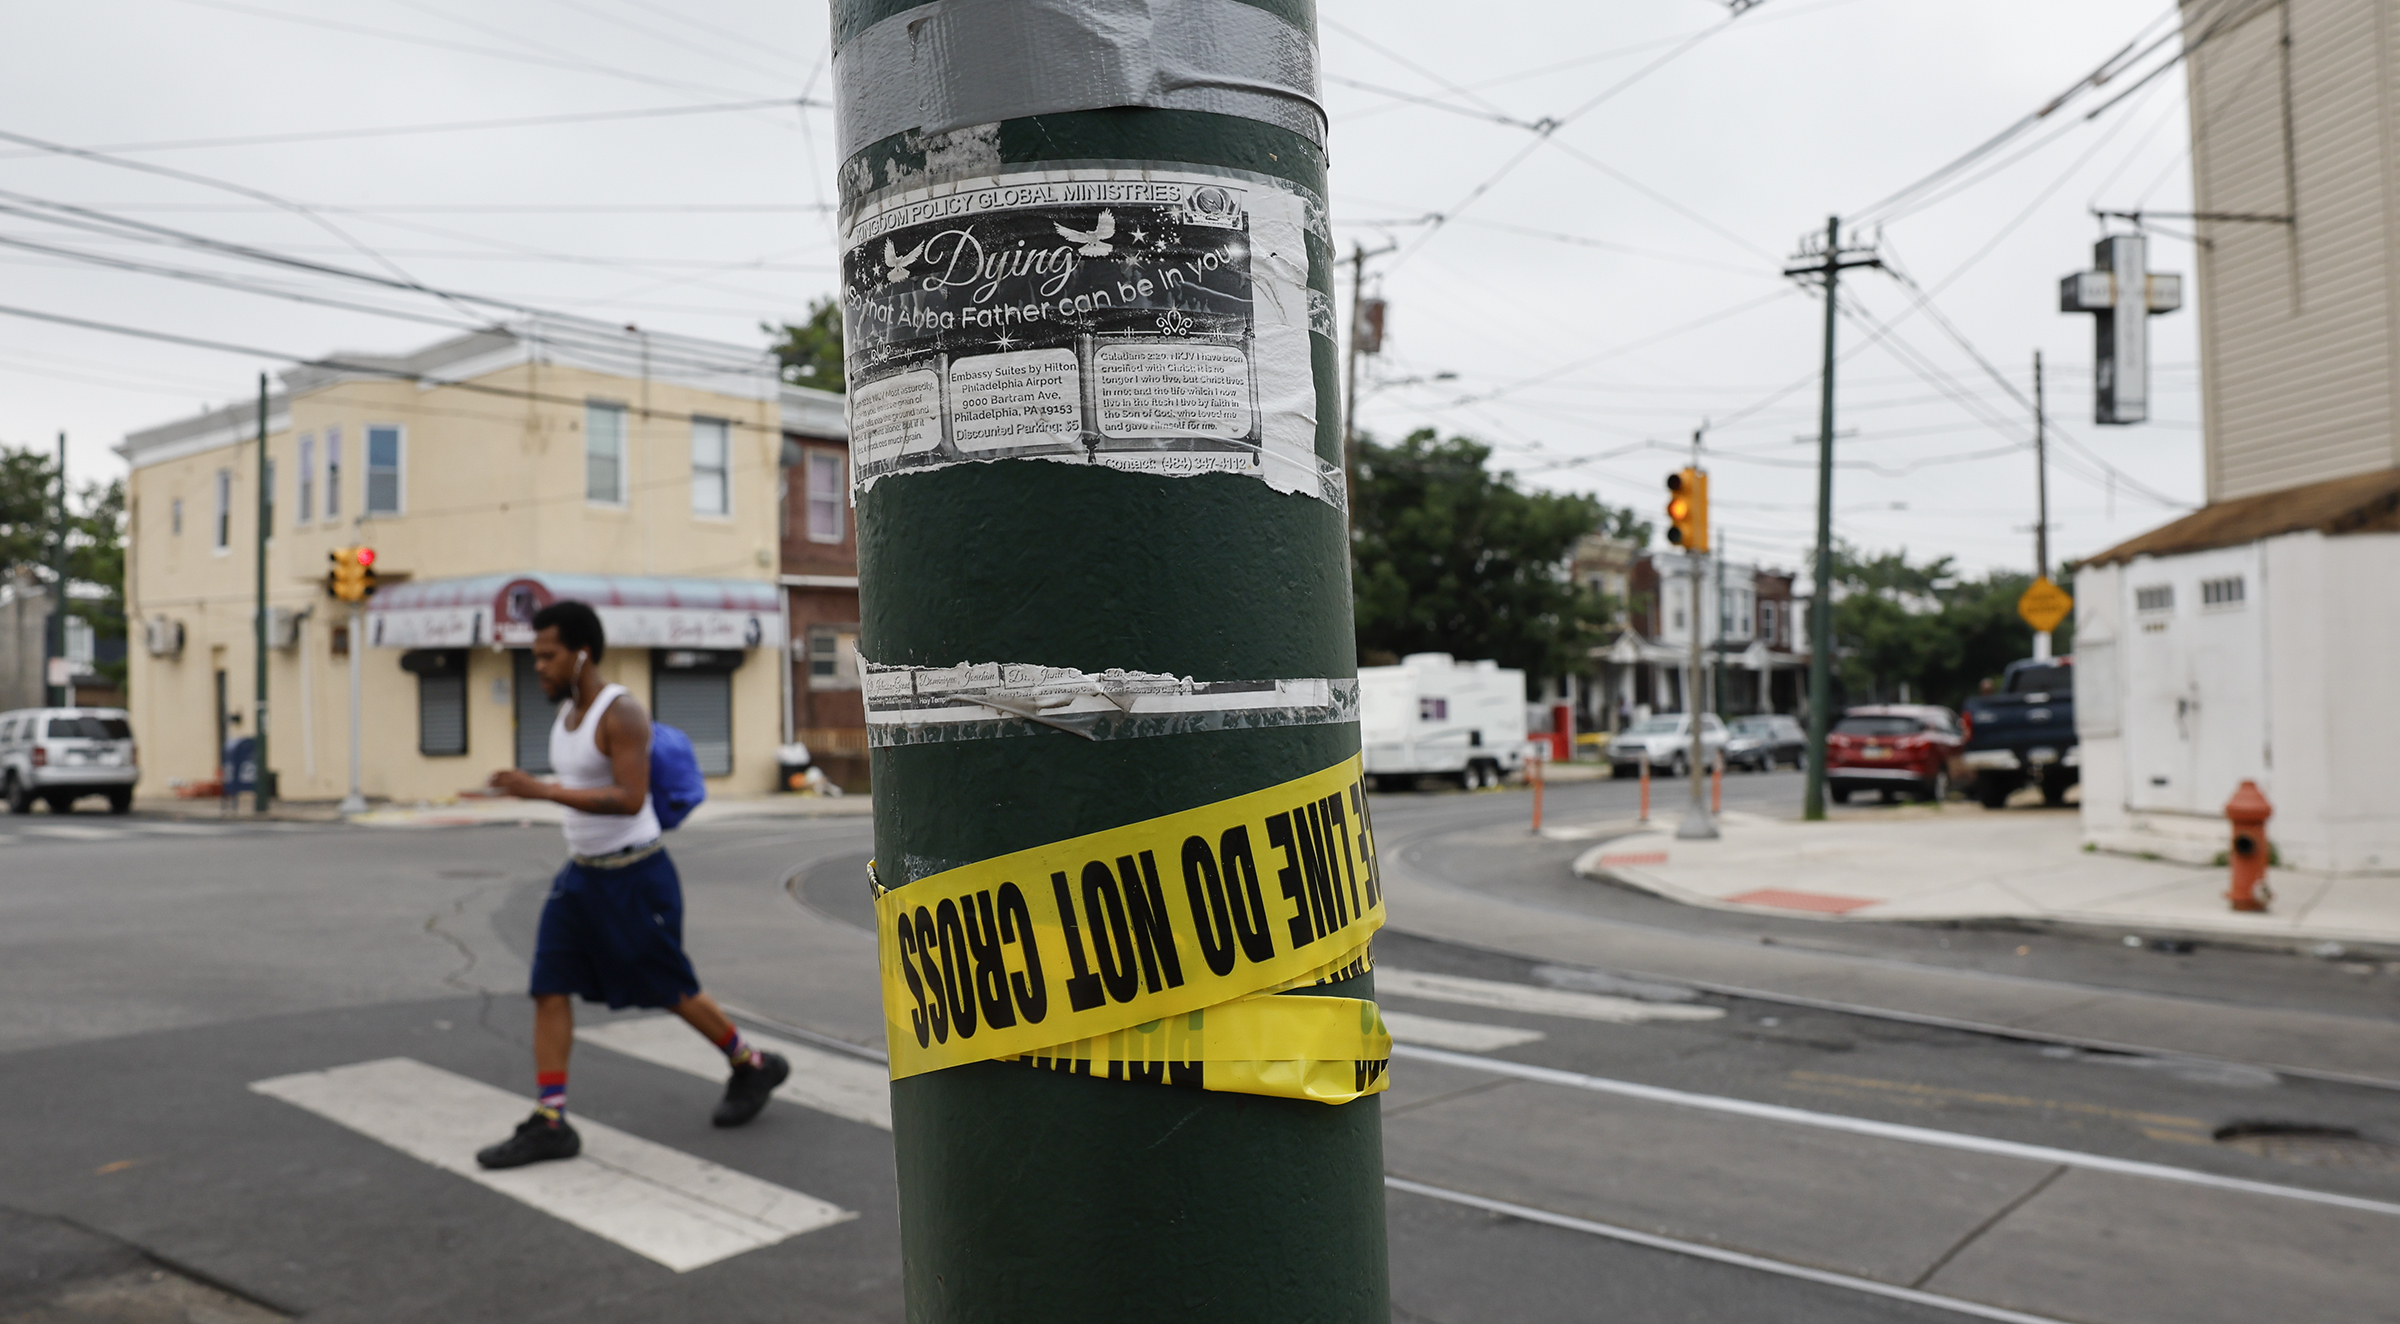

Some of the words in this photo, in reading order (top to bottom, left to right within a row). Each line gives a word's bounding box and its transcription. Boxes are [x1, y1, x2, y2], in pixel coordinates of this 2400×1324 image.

[856, 208, 909, 243] KINGDOM
[912, 194, 973, 223] POLICY
[978, 185, 1059, 209] GLOBAL
[1064, 184, 1181, 202] MINISTRIES
[922, 223, 1082, 304] Dying
[849, 285, 862, 311] So
[898, 305, 954, 330] Abba
[961, 300, 1050, 329] Father
[1059, 288, 1112, 316] can
[1117, 278, 1153, 303] be
[1186, 244, 1231, 283] you
[1100, 352, 1145, 361] Galatians
[1201, 353, 1222, 362] have
[1222, 354, 1243, 363] been
[951, 370, 992, 382] Embassy
[995, 366, 1026, 376] Suites
[1028, 364, 1042, 375] by
[1044, 362, 1077, 372] Hilton
[1101, 364, 1143, 373] crucified
[1145, 364, 1166, 373] with
[1197, 364, 1205, 373] it
[1205, 365, 1213, 373] is
[962, 378, 1024, 393] Philadelphia
[1026, 375, 1063, 388] Airport
[1102, 375, 1134, 385] longer
[1141, 375, 1161, 383] who
[1182, 375, 1199, 384] but
[1200, 375, 1226, 385] Christ
[1226, 377, 1245, 386] lives
[915, 394, 923, 403] of
[962, 397, 988, 410] 9000
[991, 392, 1035, 405] Bartram
[1102, 387, 1112, 397] in
[1133, 387, 1152, 396] and
[1153, 387, 1169, 396] the
[1170, 387, 1186, 396] life
[1187, 387, 1214, 396] which
[1219, 389, 1237, 397] now
[1103, 398, 1121, 408] live
[1122, 398, 1132, 407] in
[1133, 398, 1150, 407] the
[1151, 398, 1174, 407] flesh
[1180, 398, 1197, 407] live
[1198, 398, 1209, 409] by
[1210, 399, 1231, 408] faith
[1231, 400, 1240, 408] in
[954, 408, 1021, 423] Philadelphia,
[1023, 405, 1038, 416] PA
[1040, 404, 1073, 415] 19153
[1104, 410, 1121, 419] the
[1122, 409, 1141, 418] Son
[1142, 409, 1153, 418] of
[1177, 410, 1197, 418] who
[1197, 410, 1222, 419] loved
[956, 424, 1014, 441] Discounted
[1016, 421, 1062, 435] Parking:
[1065, 420, 1080, 432] $5
[1105, 422, 1124, 431] and
[1125, 423, 1149, 433] gave
[1187, 420, 1201, 430] for
[1265, 791, 1362, 950] LINE
[1180, 824, 1276, 977] DO
[1050, 849, 1185, 1013] NOT
[897, 881, 1048, 1049] CROSS
